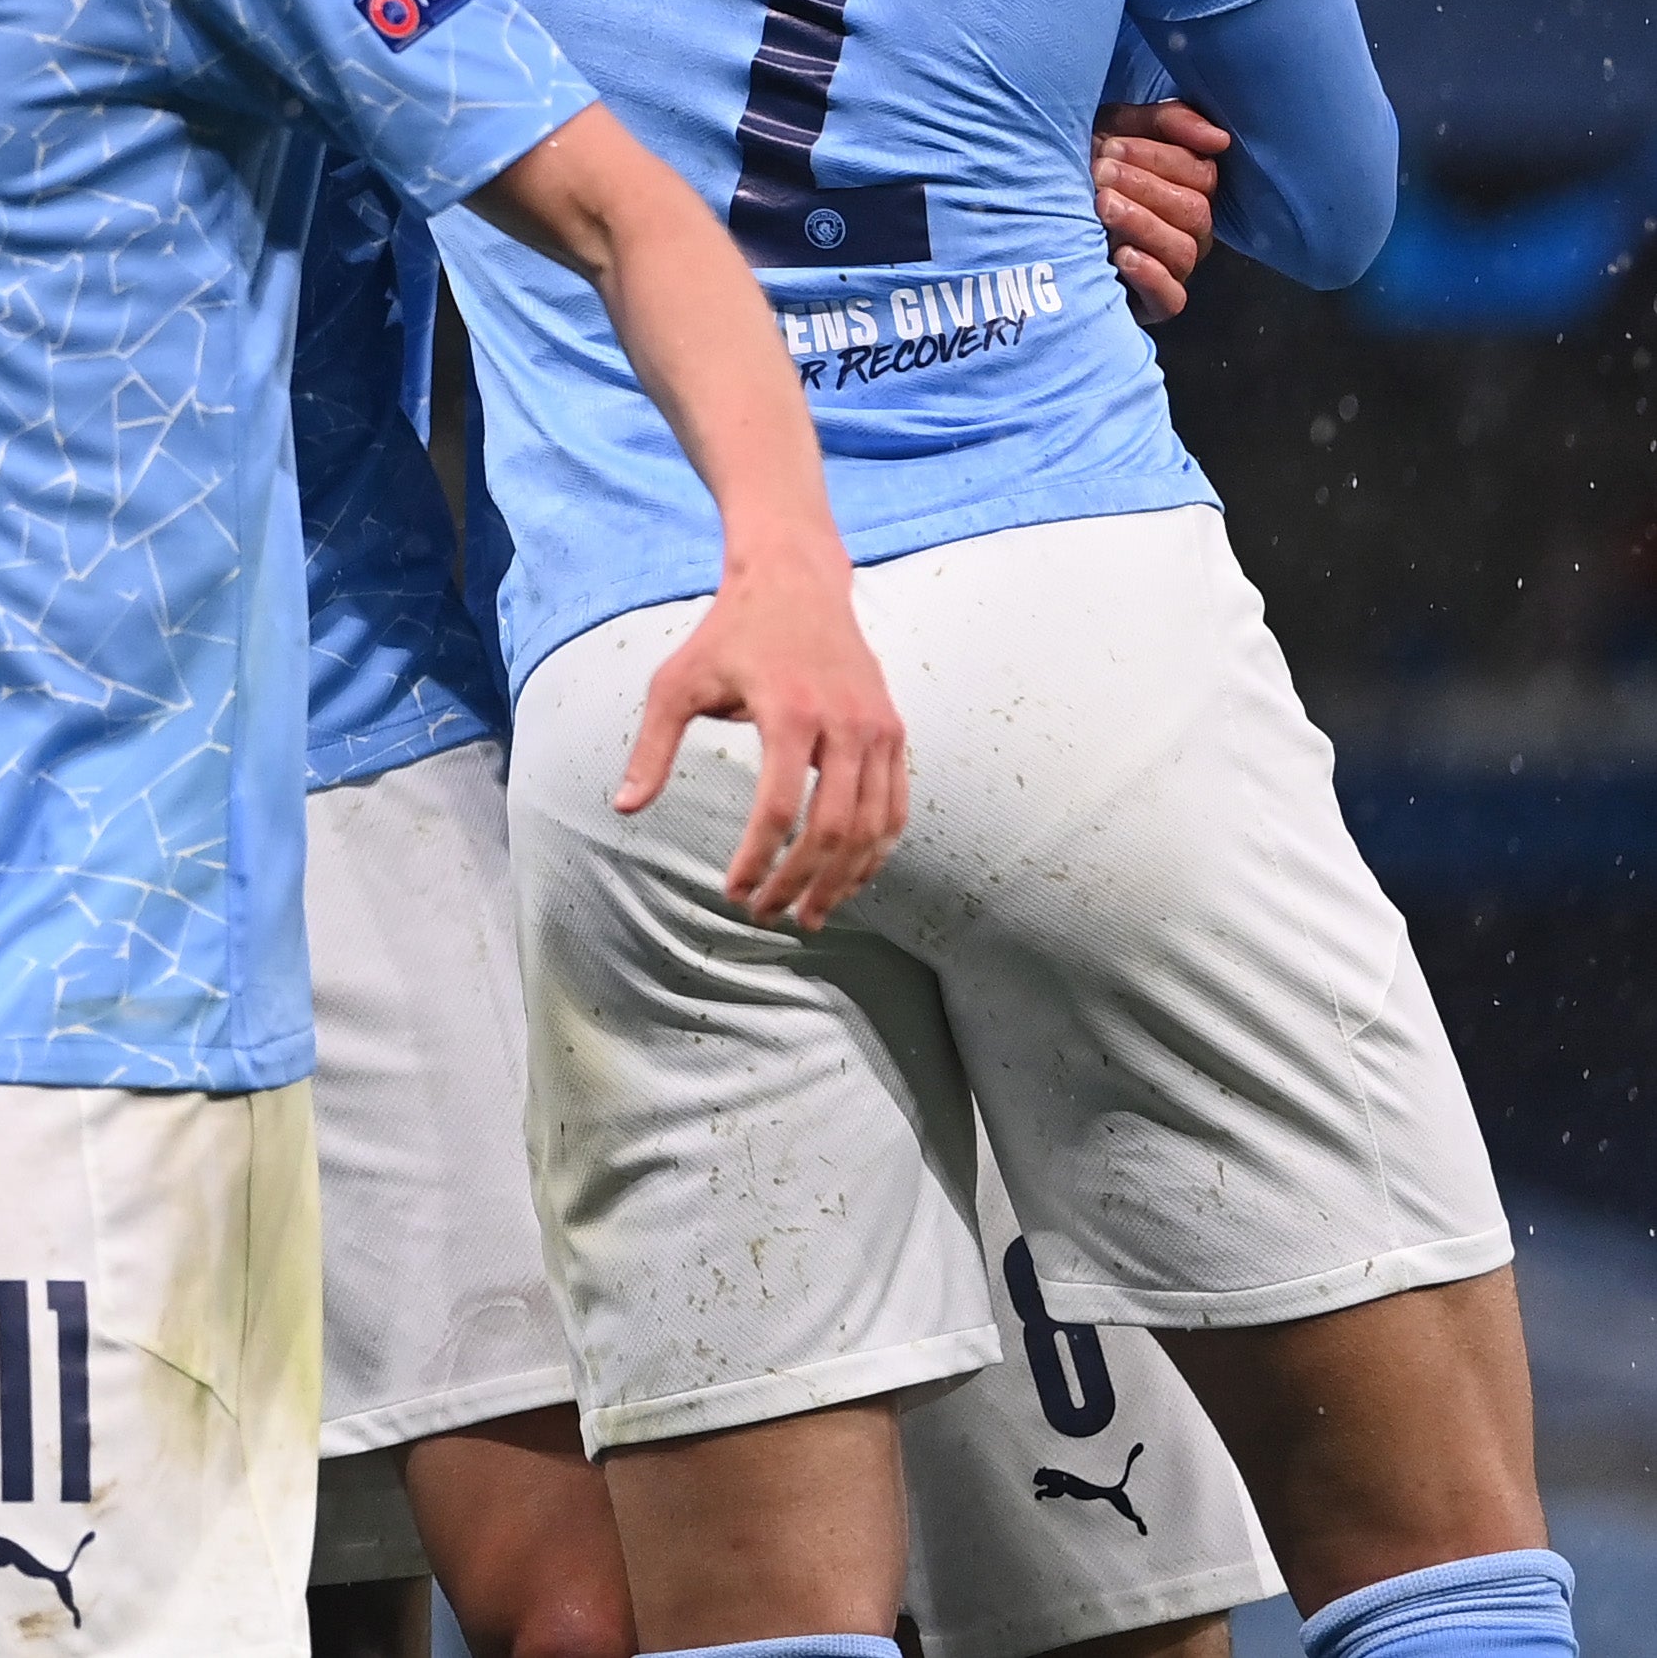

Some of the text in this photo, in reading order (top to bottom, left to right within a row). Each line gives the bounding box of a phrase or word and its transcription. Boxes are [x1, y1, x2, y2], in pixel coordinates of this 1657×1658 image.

[890, 262, 1063, 340] GIVING
[835, 309, 1027, 391] RECOVERY
[1003, 1234, 1116, 1438] 8
